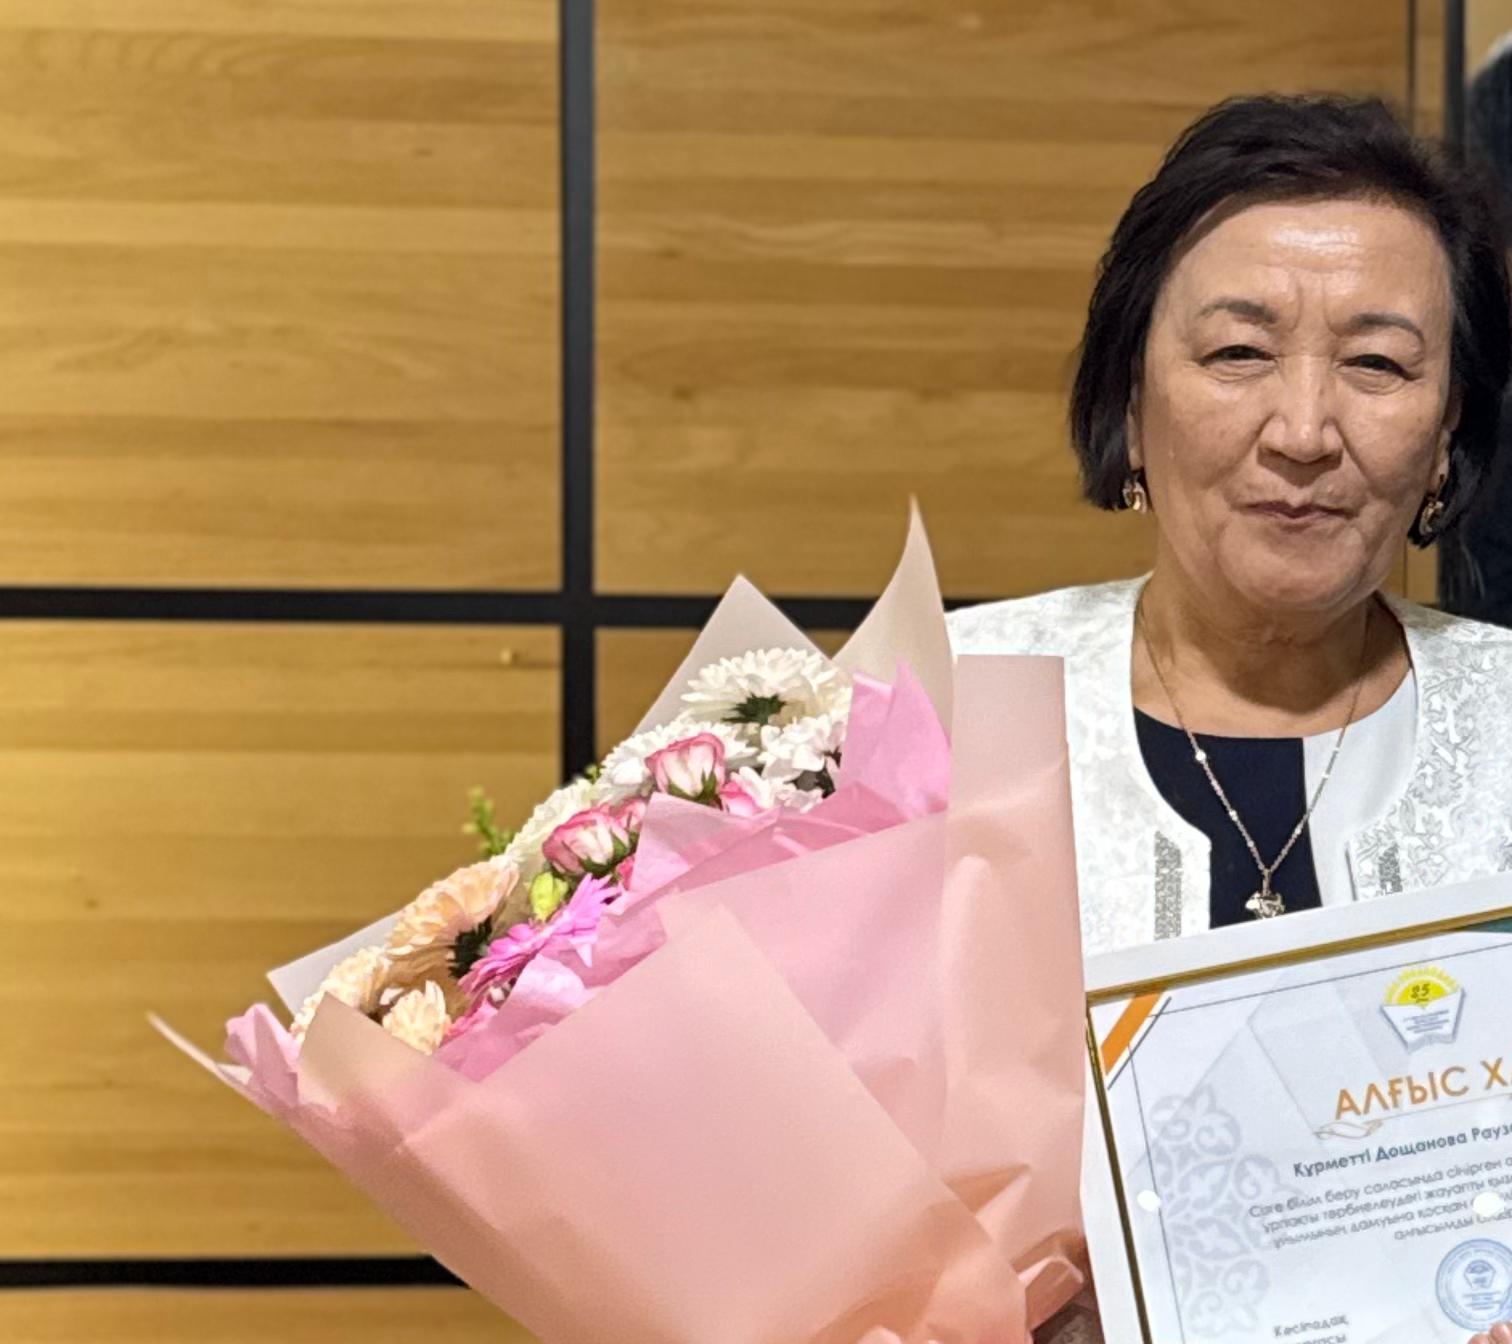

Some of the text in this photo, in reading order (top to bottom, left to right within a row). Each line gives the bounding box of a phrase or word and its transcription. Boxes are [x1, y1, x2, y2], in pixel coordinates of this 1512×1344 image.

[1334, 1064, 1471, 1121] АЛҒЫС
[1372, 1130, 1468, 1163] Дощанова
[1323, 1184, 1360, 1205] беру
